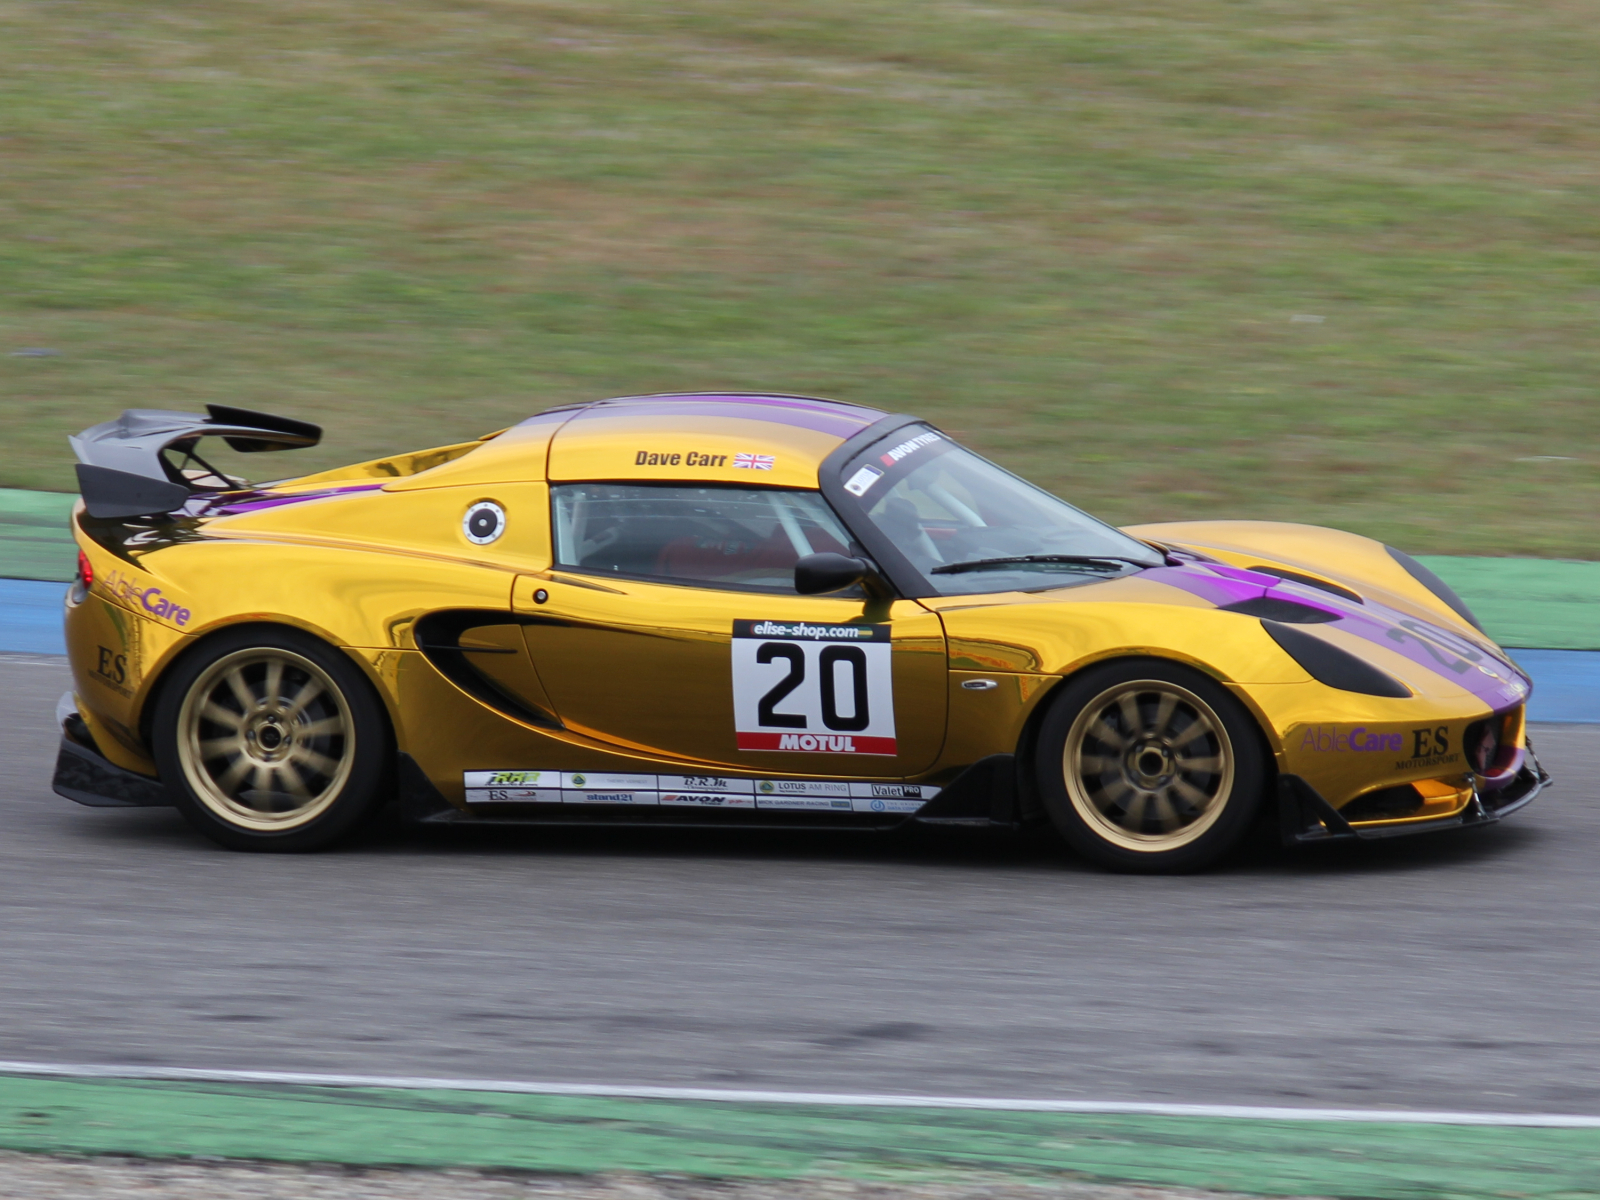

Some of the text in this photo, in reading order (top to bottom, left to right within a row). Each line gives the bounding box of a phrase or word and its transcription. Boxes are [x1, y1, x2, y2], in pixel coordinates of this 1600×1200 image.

[635, 450, 728, 467] Dave Carr
[887, 440, 920, 462] AVON
[753, 621, 859, 640] elise-shop.com
[97, 644, 127, 685] ES
[756, 641, 870, 732] 20
[779, 734, 856, 752] MOTUL
[1411, 725, 1449, 759] ES
[1395, 753, 1460, 770] MOTORSPORT
[488, 790, 508, 801] ES
[778, 782, 847, 792] LOTUS AM RING
[873, 785, 902, 796] Valet
[676, 795, 726, 803] AVON
